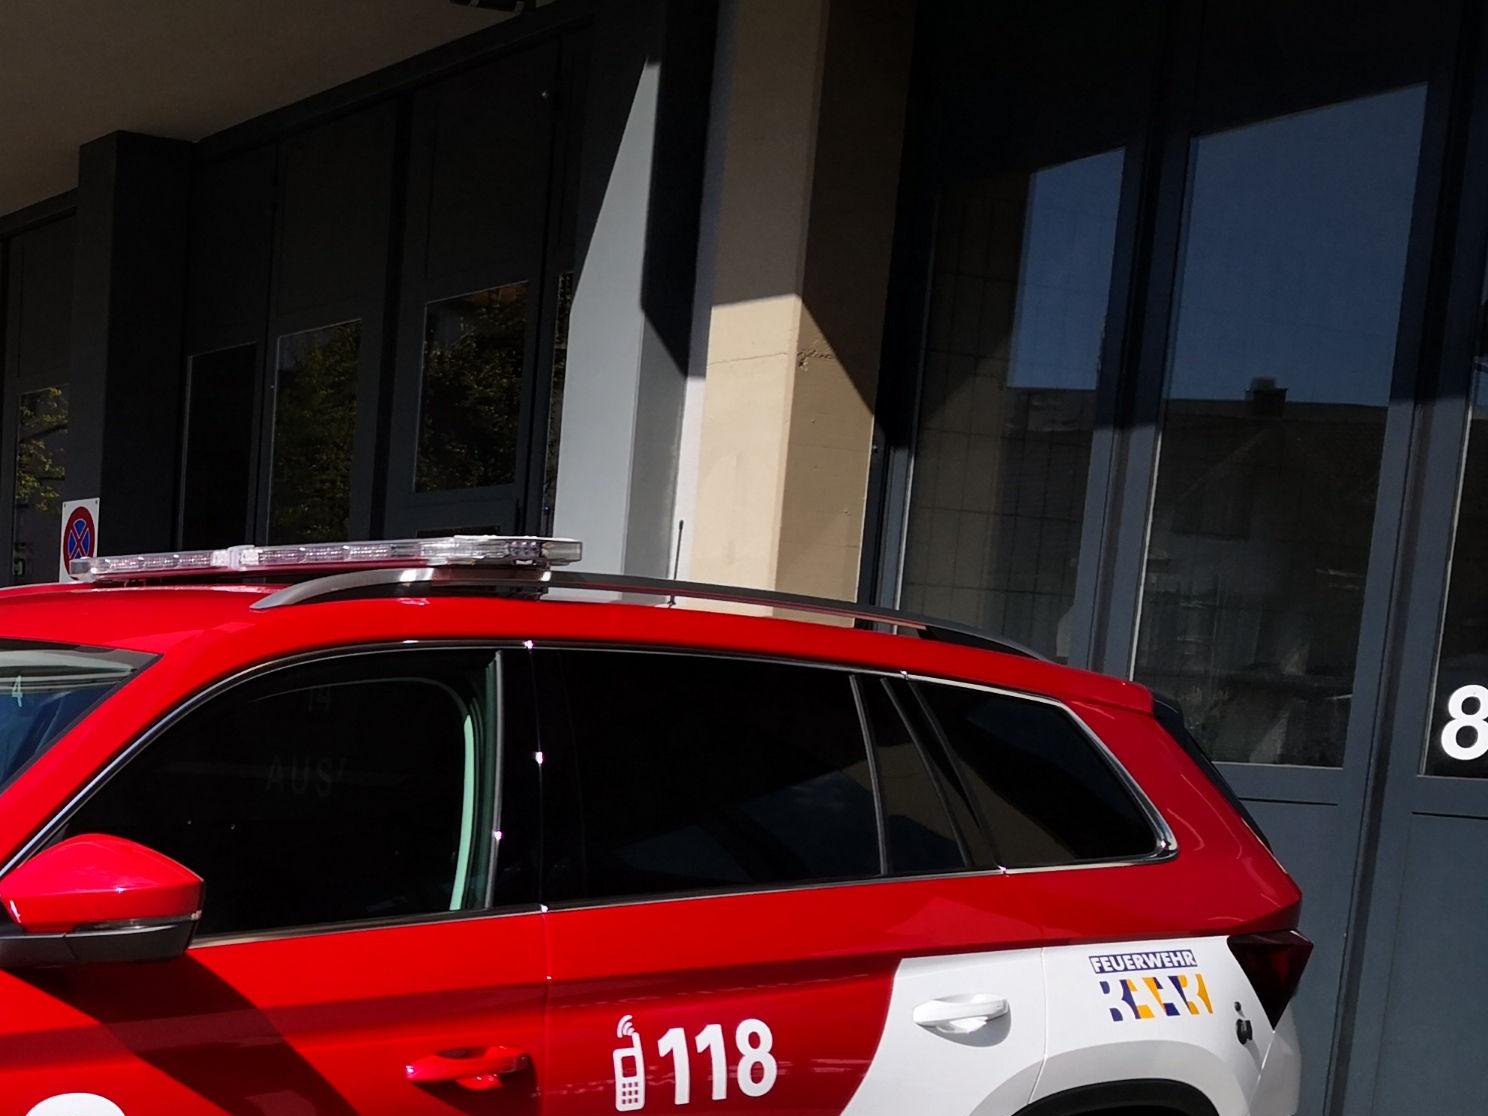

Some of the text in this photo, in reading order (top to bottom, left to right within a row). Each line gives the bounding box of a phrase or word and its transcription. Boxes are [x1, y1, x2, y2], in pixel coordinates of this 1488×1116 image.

[1440, 684, 1488, 760] 8
[1090, 950, 1197, 974] FEUERWEHR
[656, 1017, 779, 1107] 118
